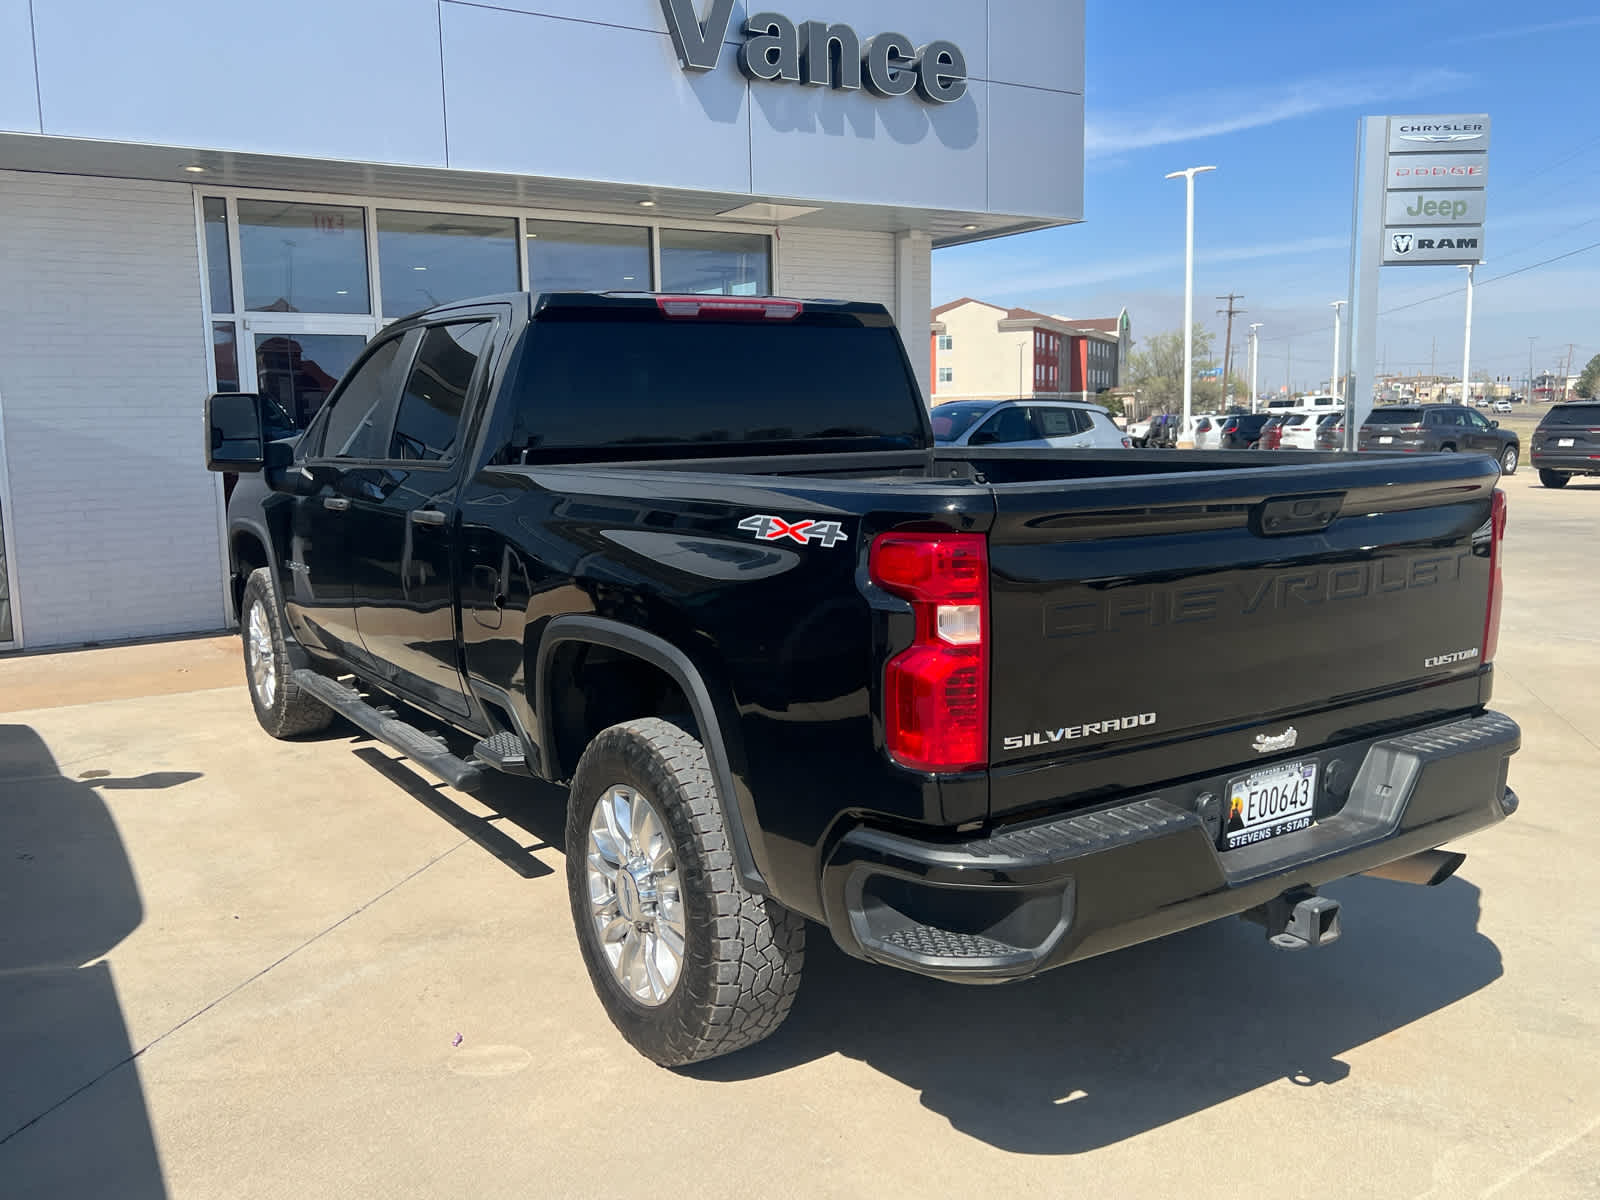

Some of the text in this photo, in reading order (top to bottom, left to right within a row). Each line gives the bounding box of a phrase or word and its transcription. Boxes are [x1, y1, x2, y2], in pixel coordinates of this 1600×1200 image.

[661, 0, 968, 104] Vance
[1400, 124, 1482, 132] CHRYSLER
[1396, 166, 1482, 176] DODGE
[1406, 195, 1467, 220] Jeep
[1418, 238, 1477, 249] RAM
[1043, 552, 1470, 639] CHEVROLET
[1424, 647, 1479, 668] CUSTOM
[1003, 712, 1157, 750] SILVERADO
[1247, 779, 1310, 821] E00643
[1229, 818, 1310, 848] STEVENS 5-STAR
